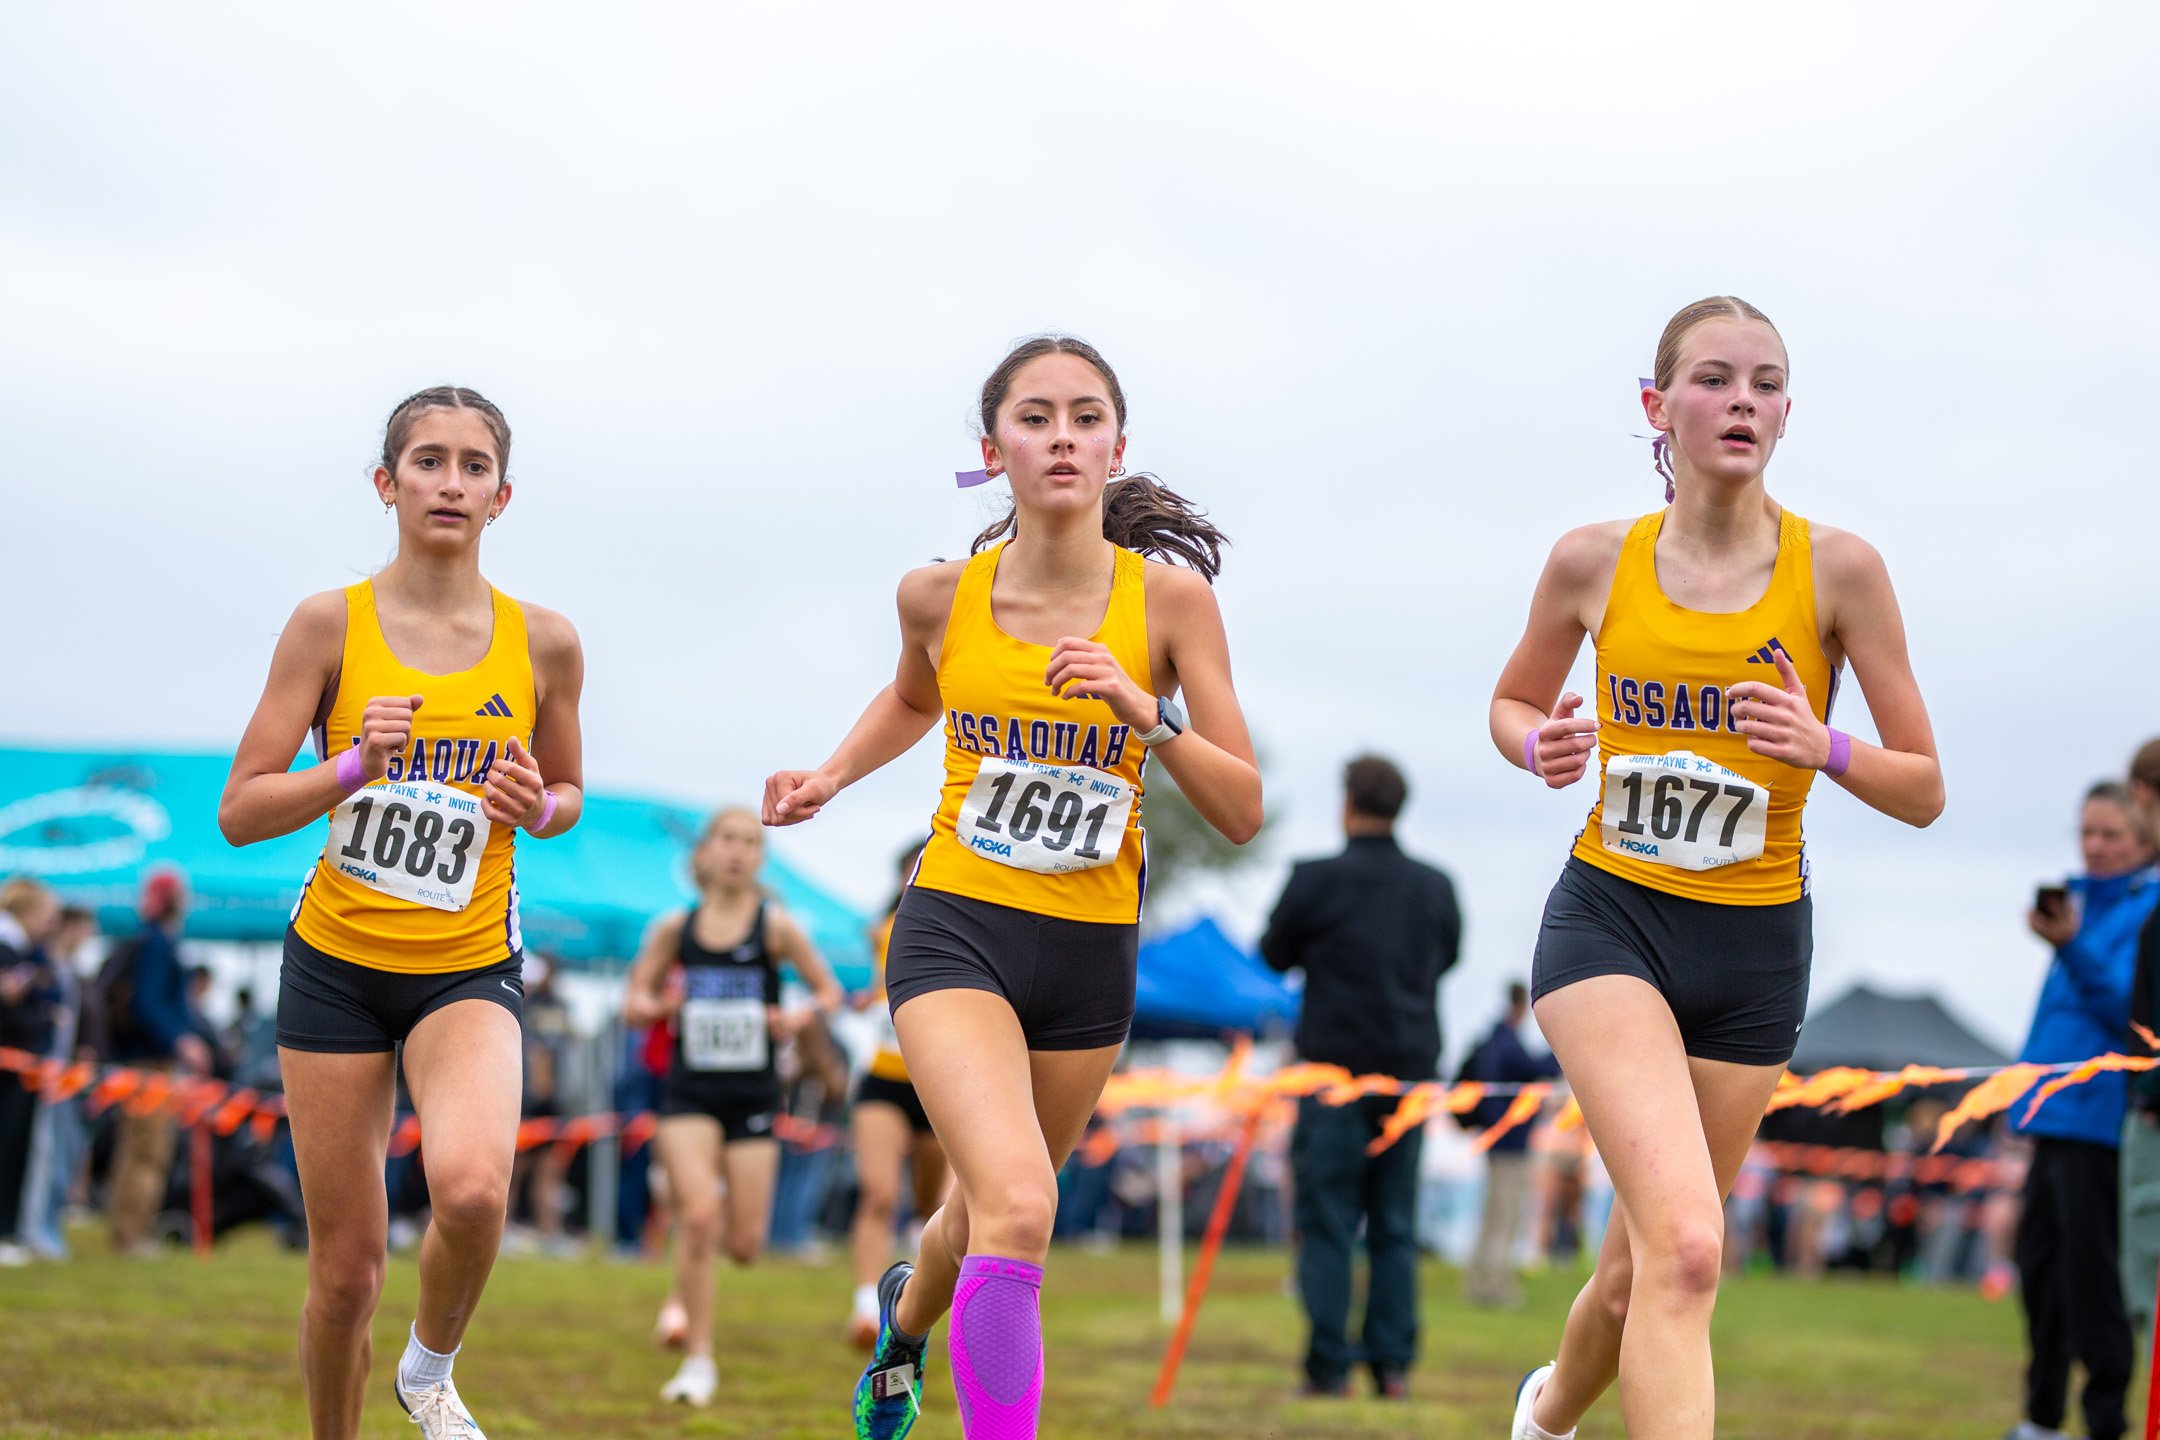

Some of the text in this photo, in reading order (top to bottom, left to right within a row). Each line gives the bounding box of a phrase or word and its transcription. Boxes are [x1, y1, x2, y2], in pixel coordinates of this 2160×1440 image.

[1608, 673, 1766, 734] ISSAQ
[949, 709, 1130, 770] ISSAQUAH
[1628, 756, 1655, 765] JOHN
[1657, 756, 1688, 769] PAYNE
[1031, 763, 1062, 779] PAYNE
[1089, 779, 1120, 799] INVITE
[389, 784, 419, 799] PAYNE
[448, 797, 477, 814] INVITE
[1618, 771, 1755, 848] 1677
[975, 771, 1109, 861] 1691
[340, 795, 475, 885] 1683
[970, 835, 1011, 858] HOKA
[1619, 838, 1659, 857] HOKA
[340, 862, 377, 883] HOKA
[417, 888, 446, 902] ROUTE
